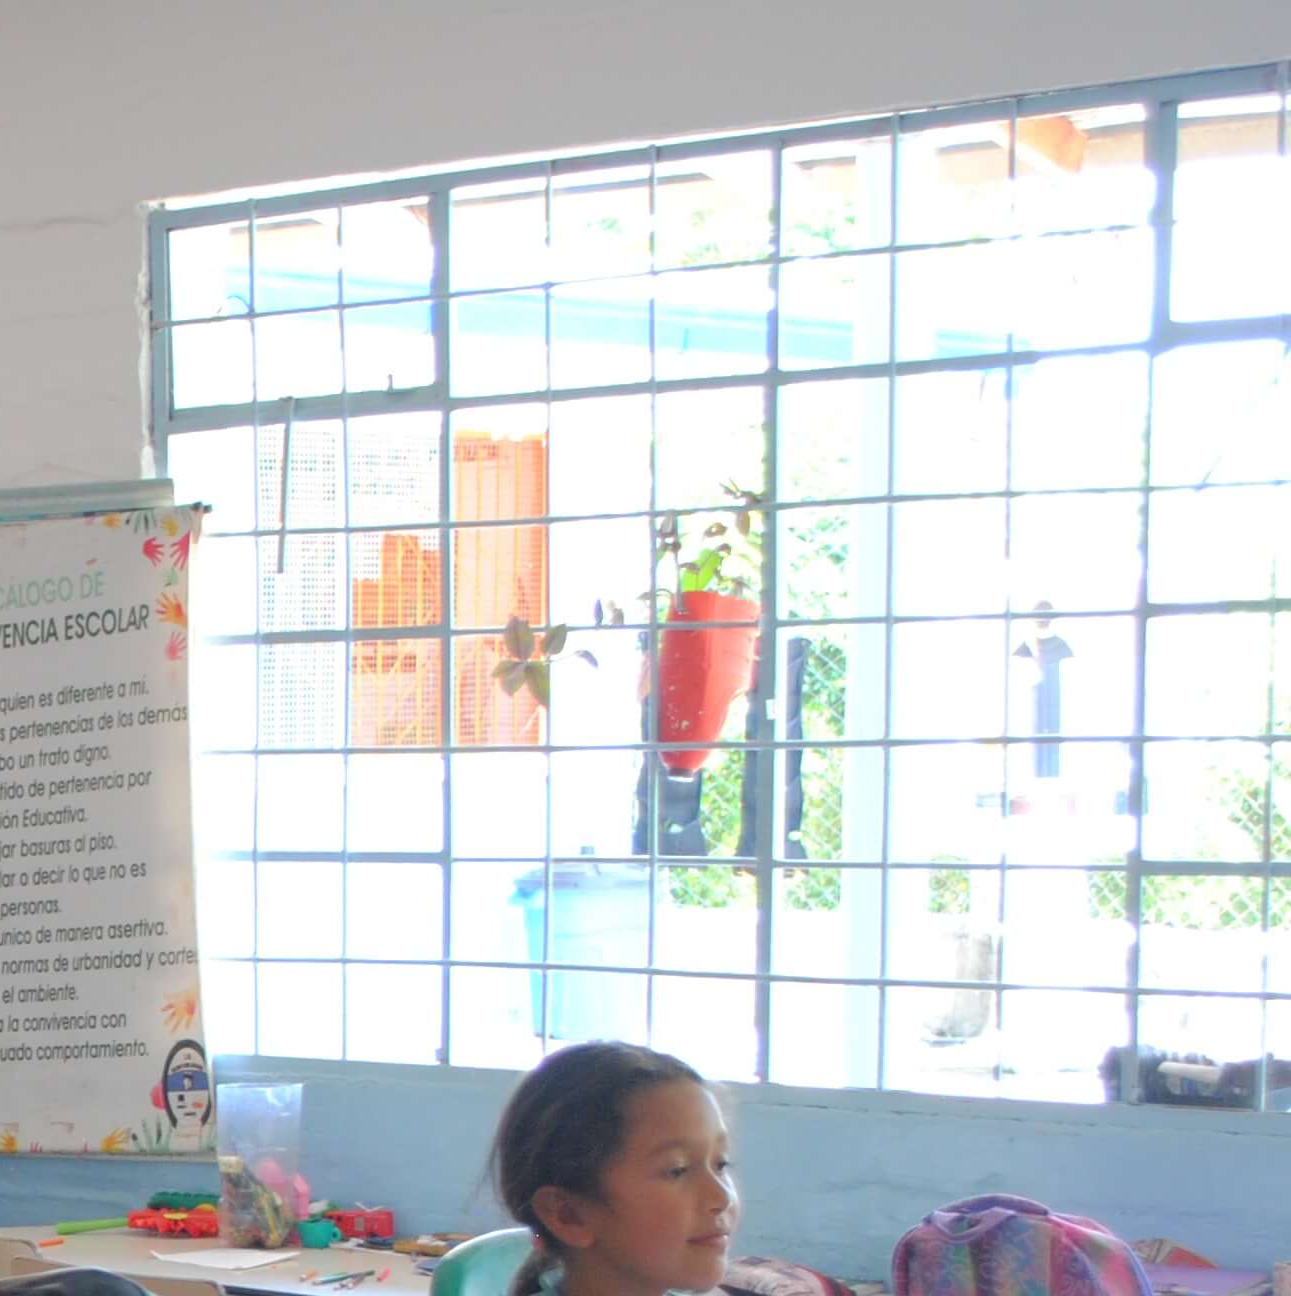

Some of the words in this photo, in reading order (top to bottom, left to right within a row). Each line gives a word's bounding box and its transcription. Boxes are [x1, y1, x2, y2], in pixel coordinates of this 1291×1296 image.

[64, 603, 150, 641] ESCOLAR
[0, 692, 34, 715] quien
[38, 691, 53, 708] es
[57, 682, 114, 705] diferente
[118, 682, 126, 698] a
[9, 713, 94, 745] pertenencias
[98, 711, 113, 731] de
[117, 709, 133, 729] los
[18, 752, 35, 769] un
[39, 747, 69, 767] trato
[73, 743, 111, 767] digno.
[28, 779, 45, 798] de
[48, 770, 124, 800] pertenencia
[127, 770, 152, 791] por
[22, 805, 89, 828] Educativa.
[20, 838, 71, 858] basuras
[74, 832, 86, 853] al
[89, 831, 118, 857] piso.
[19, 871, 29, 887] o
[32, 865, 65, 886] decir
[68, 863, 80, 883] lo
[83, 864, 106, 885] que
[109, 863, 126, 880] no
[130, 862, 147, 878] es
[0, 898, 61, 921] personas.
[35, 925, 52, 944] de
[56, 924, 103, 943] manera
[107, 918, 169, 940] asertiva.
[1, 958, 50, 976] normas
[52, 953, 69, 973] de
[72, 948, 143, 972] urbanidad
[146, 951, 155, 971] y
[2, 984, 15, 1004] el
[17, 983, 80, 1003] ambiente.
[7, 1014, 20, 1032] la
[22, 1010, 97, 1032] convivencia
[100, 1013, 127, 1029] con
[36, 1038, 150, 1064] comportamiento.
